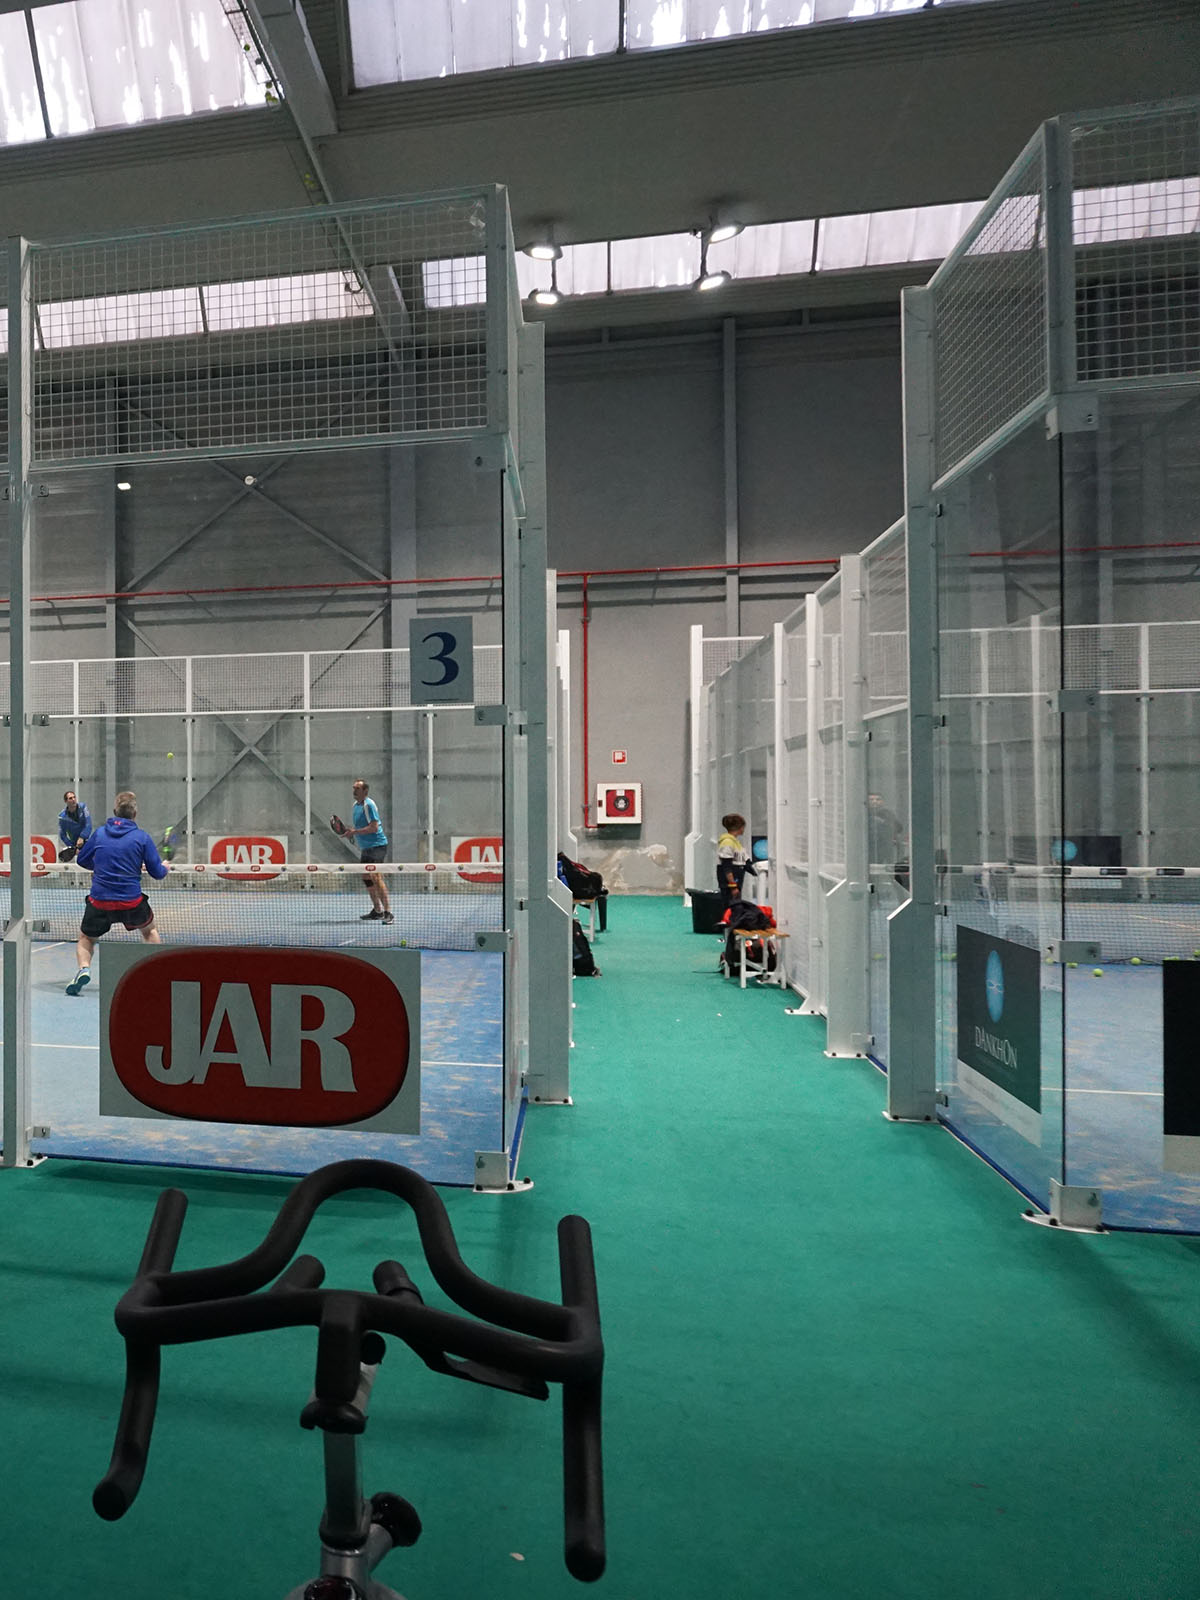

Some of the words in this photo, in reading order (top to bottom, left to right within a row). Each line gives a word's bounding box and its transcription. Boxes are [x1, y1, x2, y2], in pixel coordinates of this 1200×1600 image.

[421, 632, 459, 686] 3
[220, 845, 273, 864] JAR
[471, 846, 503, 863] JA
[145, 981, 358, 1093] JAR
